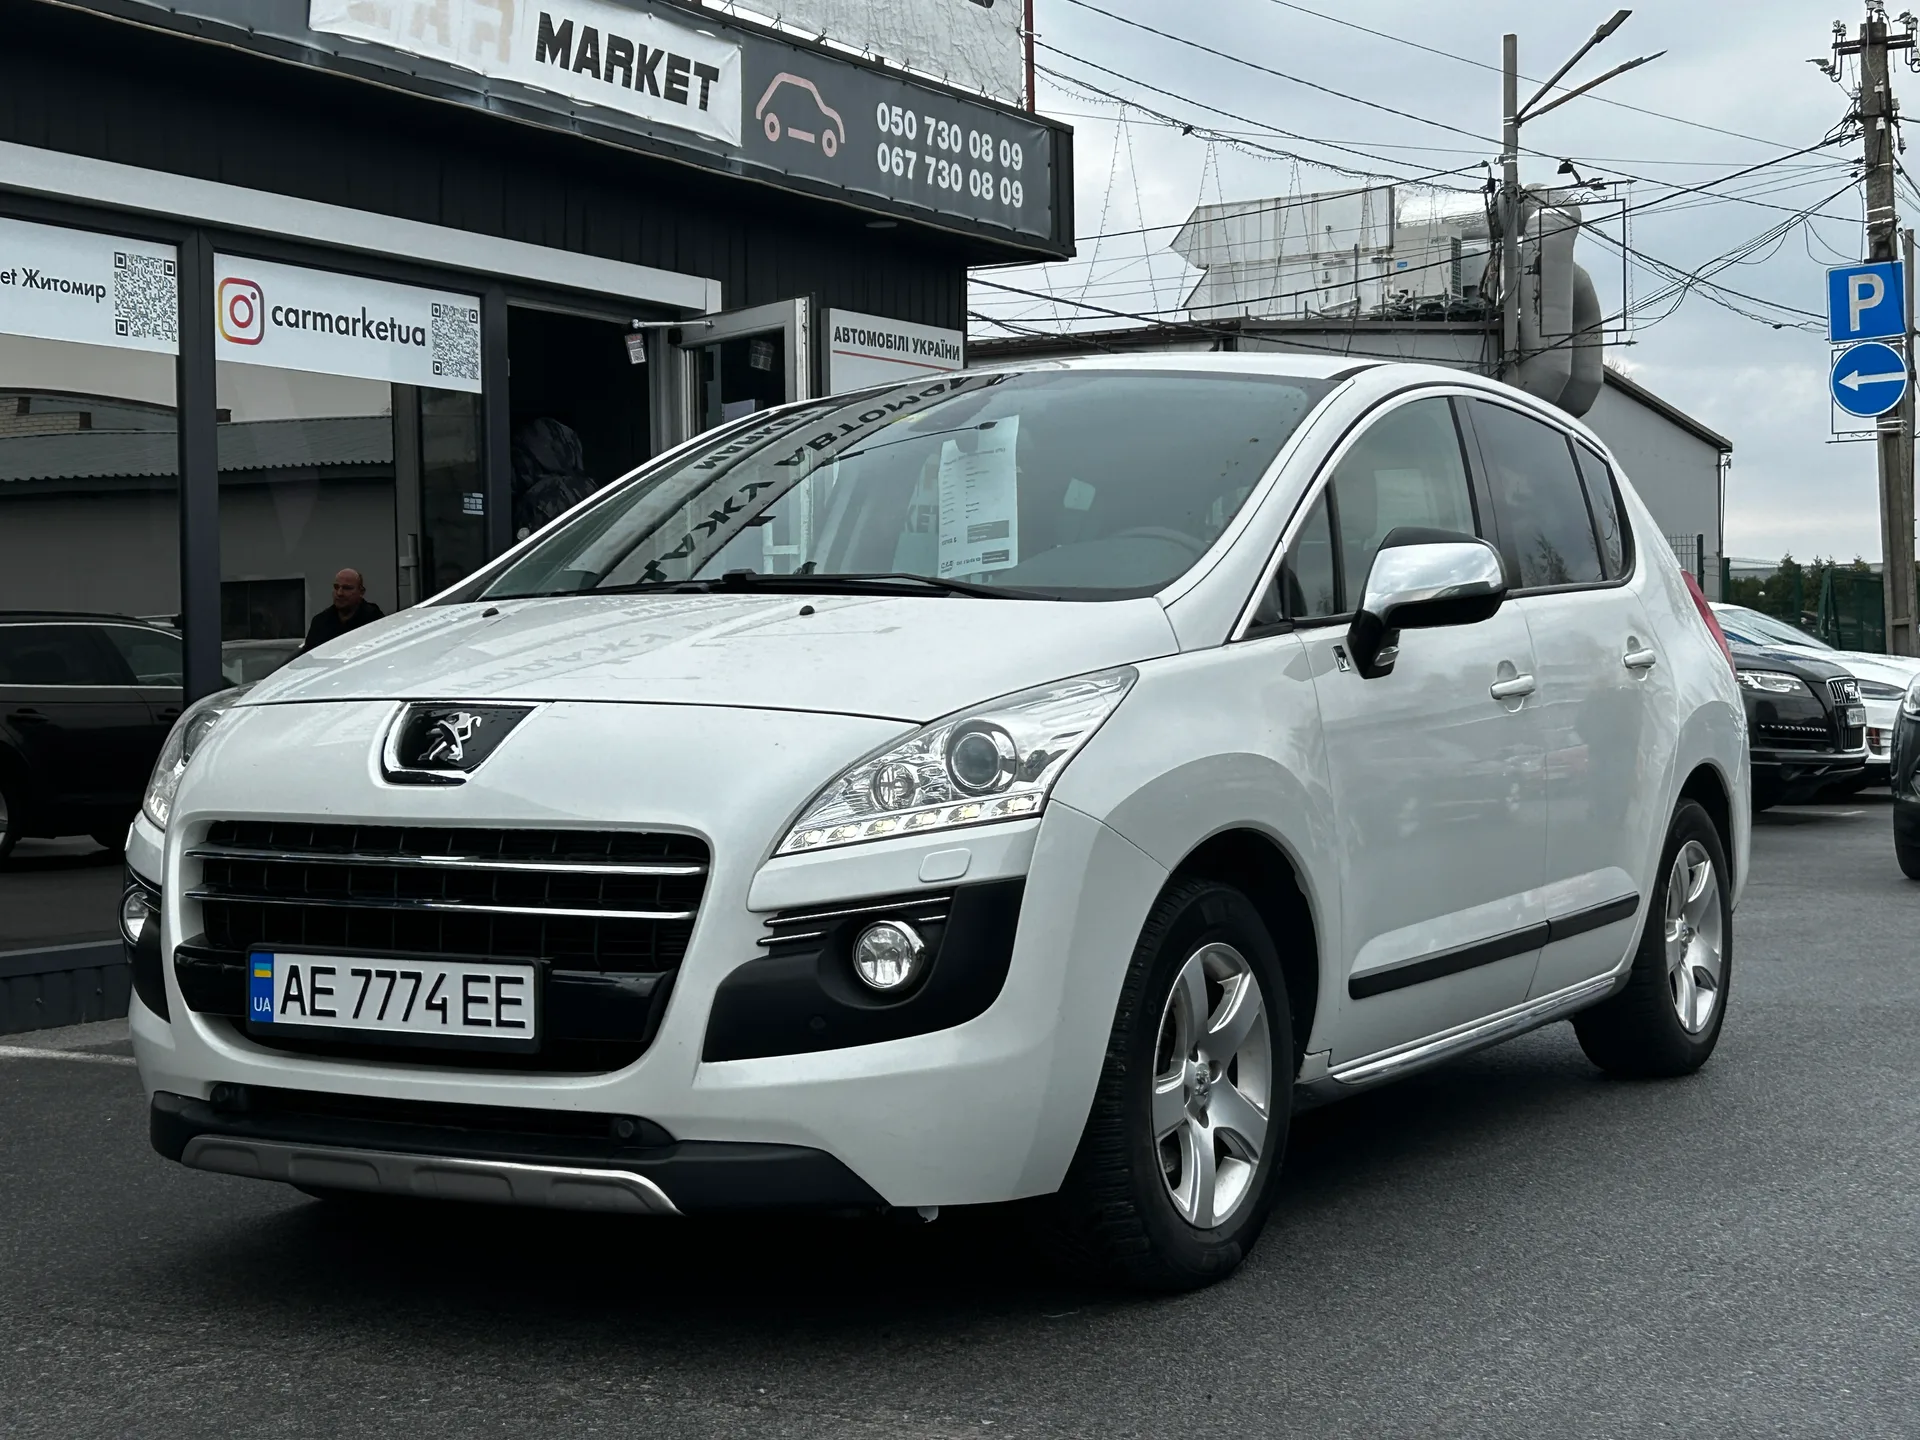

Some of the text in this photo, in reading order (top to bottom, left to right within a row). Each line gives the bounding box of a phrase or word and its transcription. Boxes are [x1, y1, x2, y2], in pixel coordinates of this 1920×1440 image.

[535, 12, 720, 112] MARKET
[876, 102, 1023, 171] 050 730 08 09
[877, 143, 1024, 208] 067 730 08 09
[22, 267, 106, 303] Житомир
[1848, 273, 1885, 332] P
[271, 305, 426, 346] carmarketua
[834, 326, 960, 361] АВТОМОБІЛІ УКРАЇНИ
[254, 965, 526, 1029] UA AE 7774 EE
